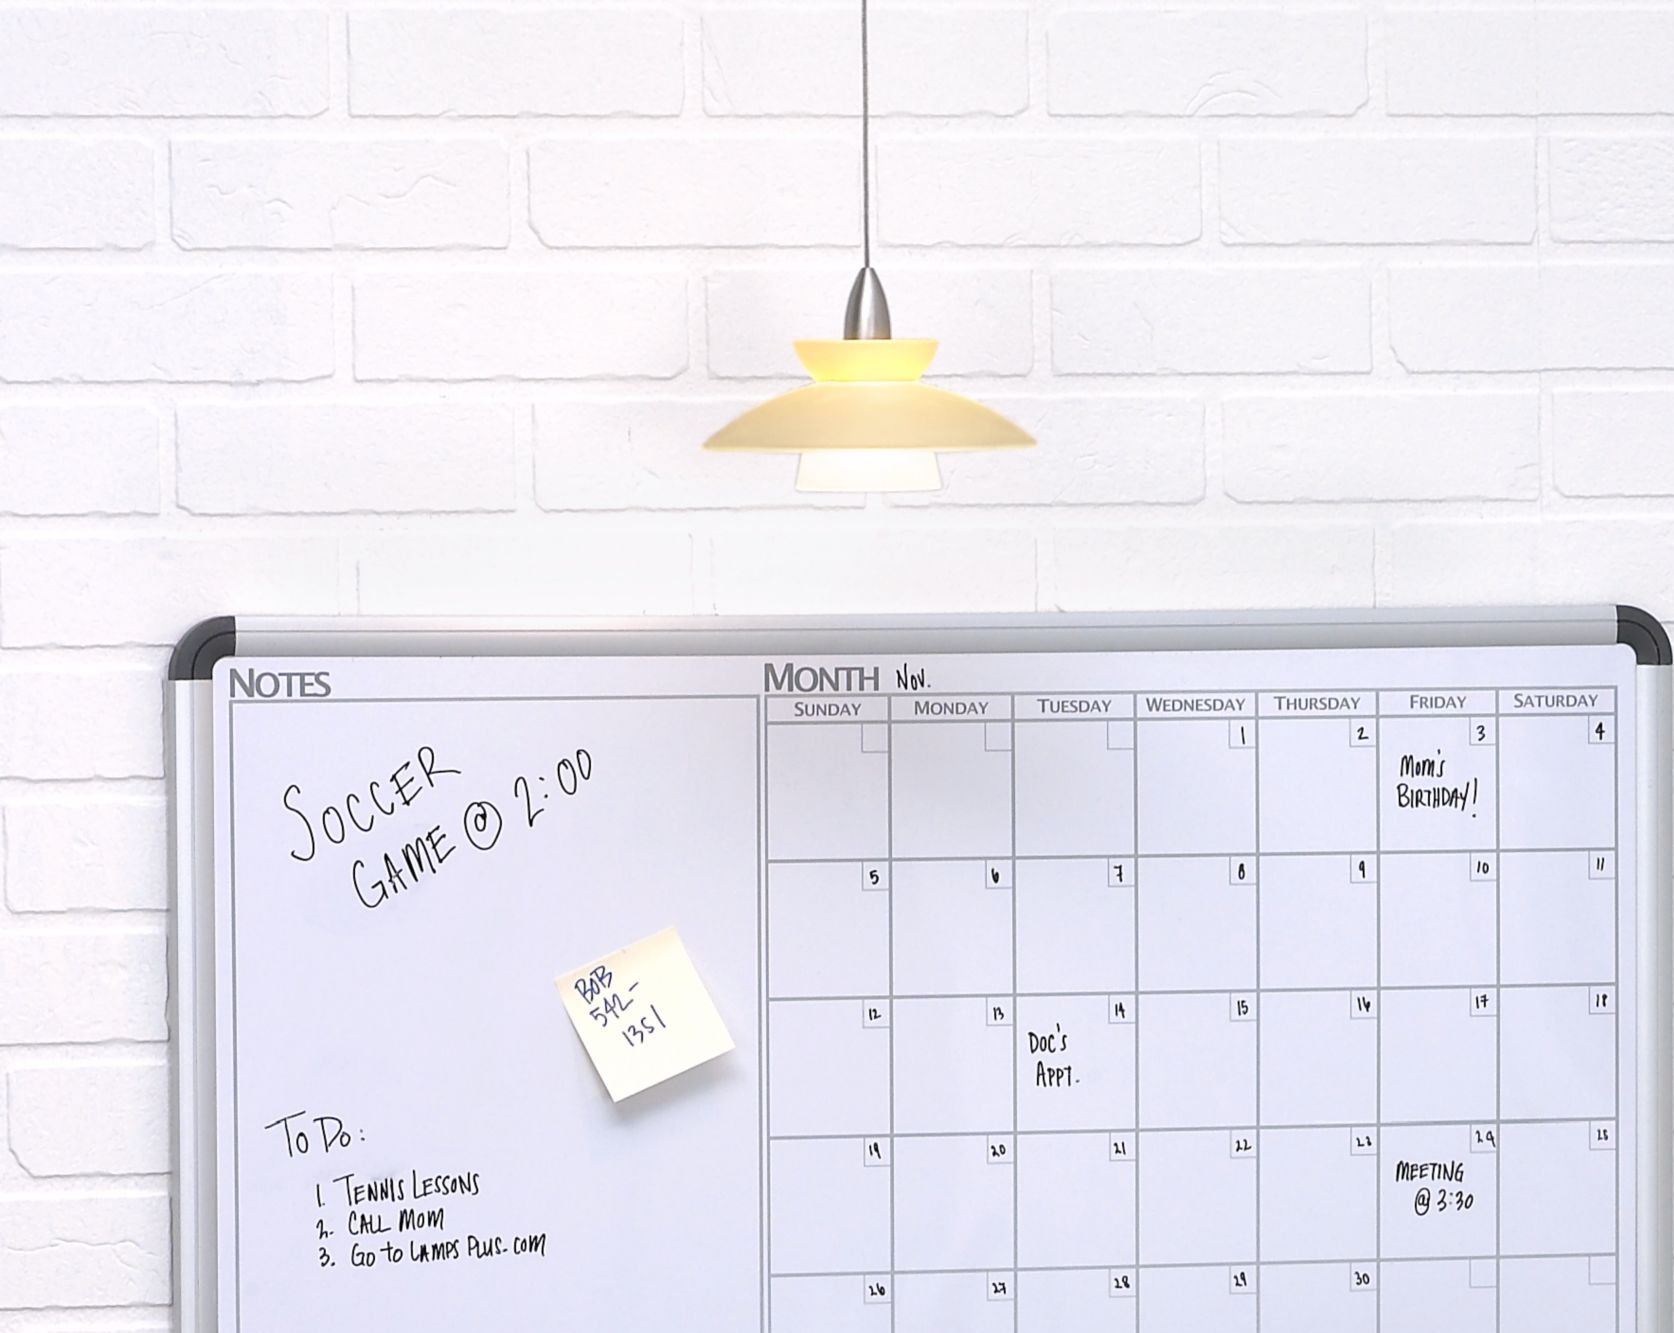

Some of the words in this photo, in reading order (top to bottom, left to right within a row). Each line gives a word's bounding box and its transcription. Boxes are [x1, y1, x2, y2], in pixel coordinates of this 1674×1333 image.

[229, 667, 332, 699] NOTES
[764, 662, 880, 693] MONTH
[794, 701, 862, 717] SUNDAY
[914, 700, 989, 716] MONDAY
[1036, 698, 1112, 714] TUESDAY
[1145, 697, 1246, 713] WEDNESDAY
[1273, 695, 1361, 711] THURSDAY
[1409, 694, 1467, 710] FRIDAY
[1513, 692, 1599, 709] SATURDAY
[1240, 725, 1246, 745] 1
[1356, 726, 1370, 741] 2
[1476, 724, 1486, 742] 3
[1594, 721, 1606, 741] 4
[283, 746, 462, 862] SOCCER
[1395, 776, 1478, 819] BIRTHDAY!
[351, 819, 457, 909] GAME
[513, 748, 592, 828] 2:00
[990, 867, 1000, 884] 6
[1113, 864, 1123, 883] 7
[1358, 860, 1366, 879] 9
[1476, 860, 1490, 875] 10
[869, 869, 880, 886] 5
[1114, 1001, 1126, 1019] 14
[1236, 999, 1249, 1017] 15
[1356, 995, 1371, 1013] 16
[1475, 993, 1490, 1010] 17
[868, 1007, 882, 1022] 12
[992, 1006, 1005, 1022] 13
[868, 1141, 882, 1160] 19
[990, 1143, 1007, 1158] 20
[1113, 1141, 1127, 1156] 21
[1235, 1138, 1253, 1153] 22
[1395, 1159, 1465, 1183] MEETING
[332, 1172, 405, 1207] TENNIS
[412, 1168, 480, 1200] LESSONS
[1436, 1188, 1475, 1213] 3:30
[347, 1209, 393, 1236] CALL
[318, 1246, 336, 1268] 3.
[1113, 1274, 1131, 1290] 28
[1233, 1271, 1248, 1288] 29
[1354, 1270, 1371, 1286] 30
[868, 1282, 886, 1297] 26
[991, 1281, 1007, 1295] 27
